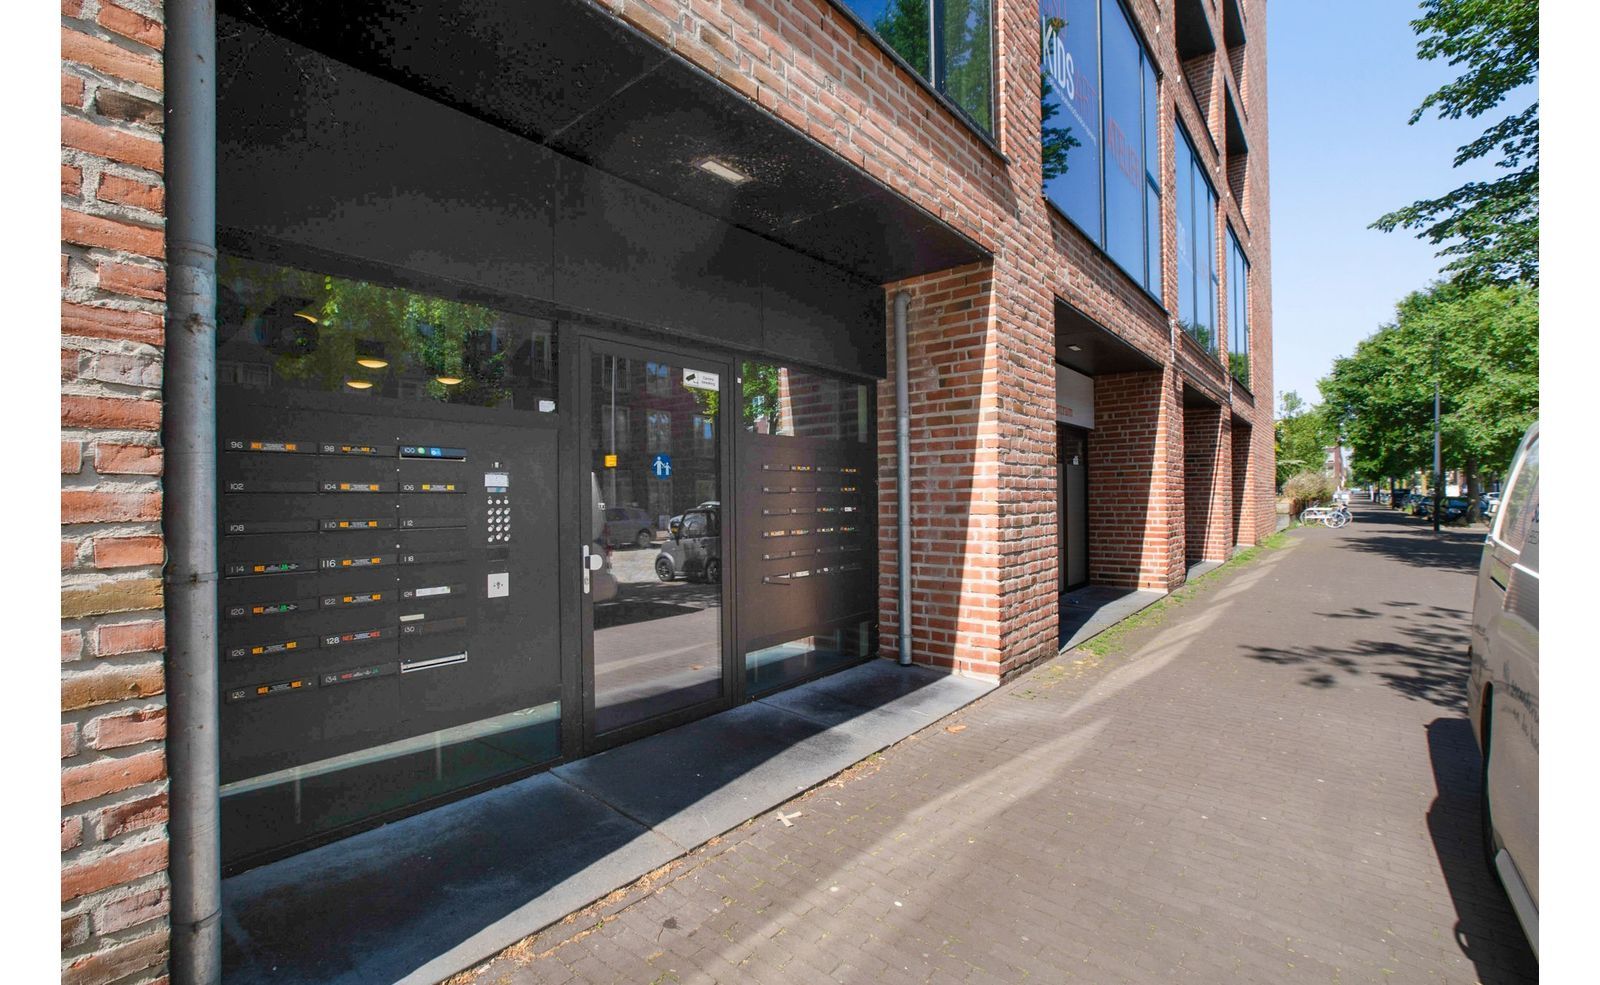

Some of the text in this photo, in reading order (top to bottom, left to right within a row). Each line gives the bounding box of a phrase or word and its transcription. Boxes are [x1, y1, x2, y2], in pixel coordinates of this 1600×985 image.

[1043, 15, 1075, 100] KIDS
[231, 441, 243, 449] 96
[230, 483, 244, 491] 102
[230, 524, 245, 532] 108
[324, 521, 337, 529] 110
[322, 559, 336, 568] 116
[231, 565, 244, 573] 114
[324, 598, 336, 606] 122
[231, 608, 244, 616] 120
[326, 636, 340, 645] 128
[232, 648, 245, 657] 126
[325, 675, 337, 683] 134
